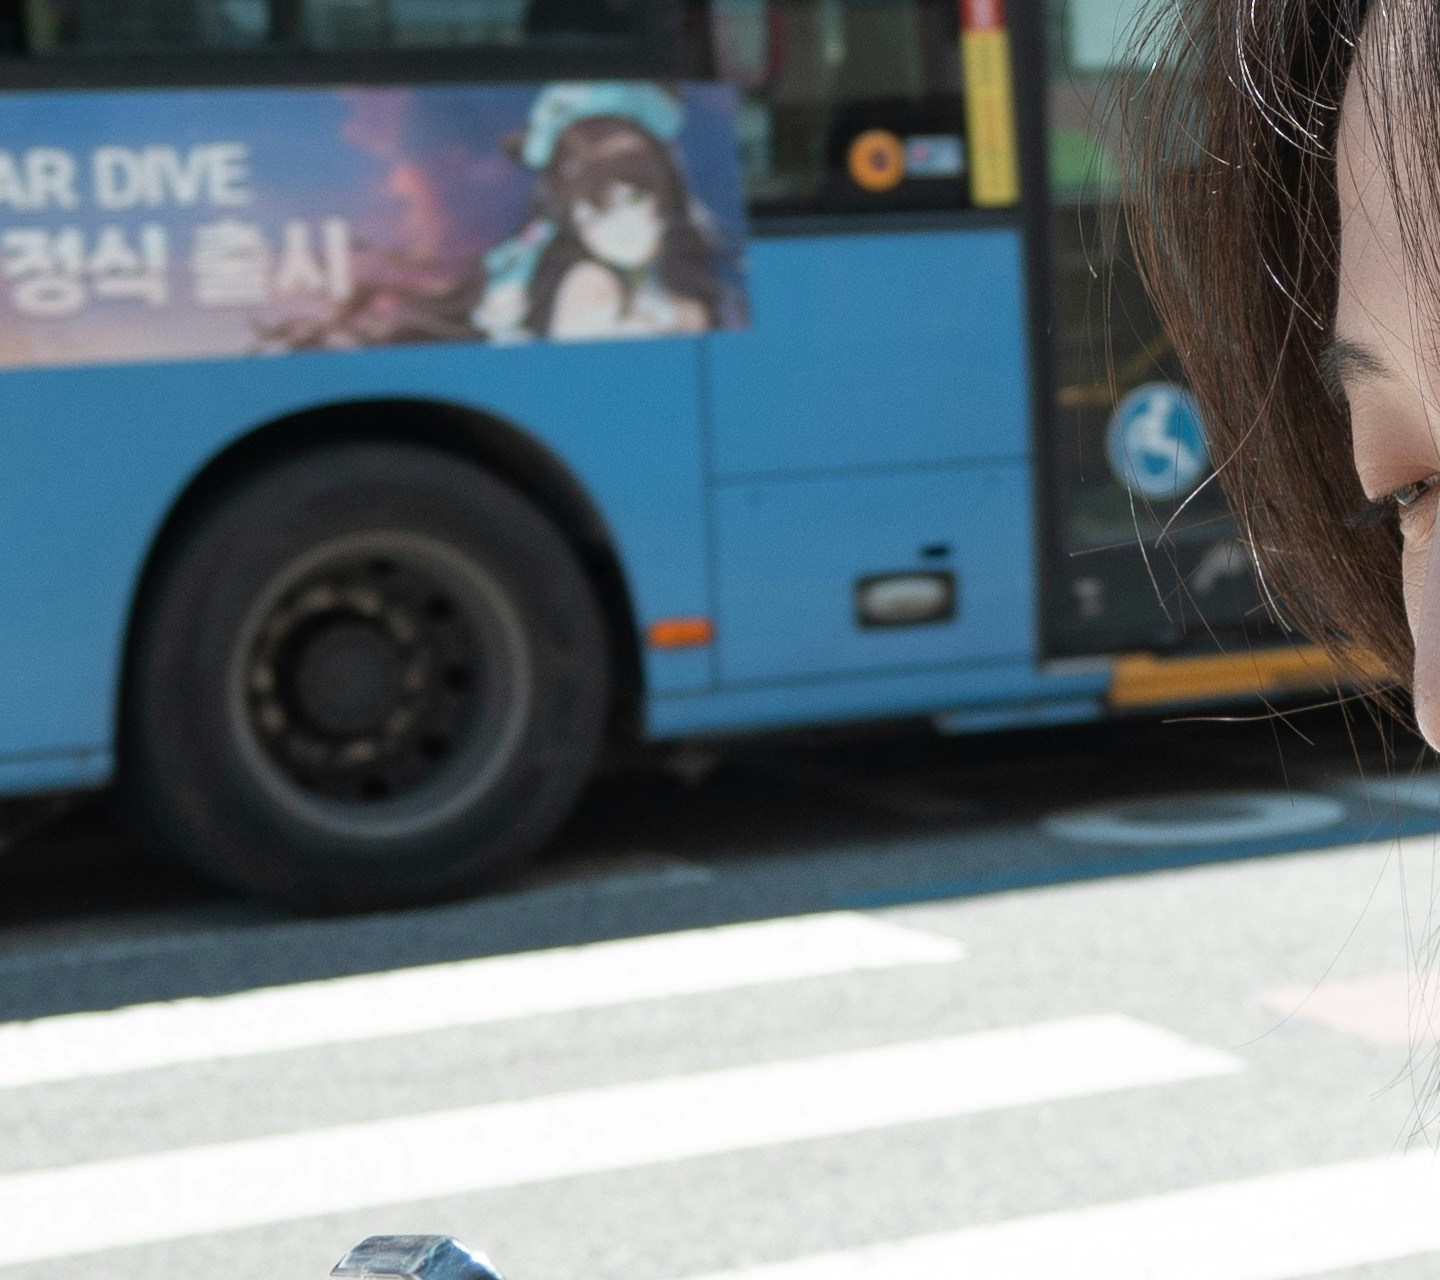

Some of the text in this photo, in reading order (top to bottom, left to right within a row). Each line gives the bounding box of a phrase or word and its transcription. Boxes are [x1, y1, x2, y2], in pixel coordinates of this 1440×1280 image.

[92, 142, 252, 209] DIVE
[0, 224, 171, 317] 정식
[190, 217, 356, 310] 출시
